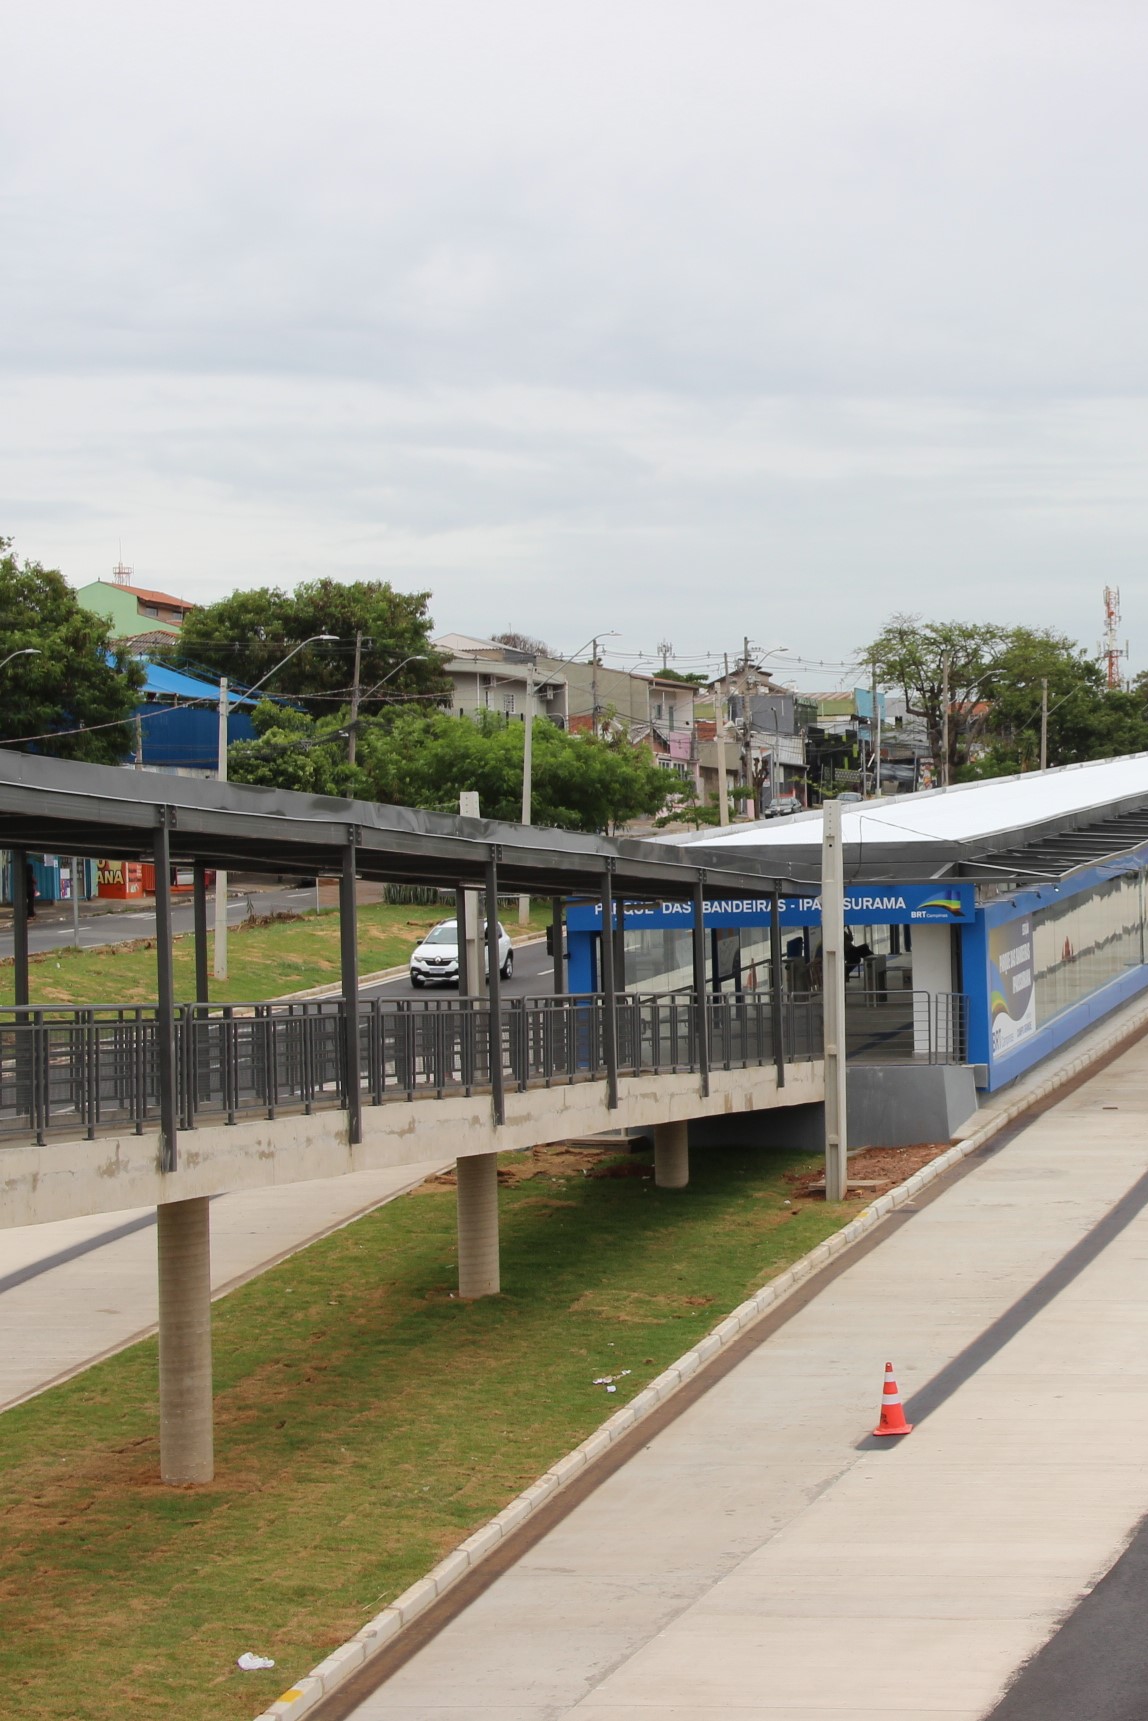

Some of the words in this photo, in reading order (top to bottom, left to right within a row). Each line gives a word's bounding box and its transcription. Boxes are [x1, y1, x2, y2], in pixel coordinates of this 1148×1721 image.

[662, 902, 692, 914] DAS
[702, 900, 786, 913] BANDEIRAS
[799, 897, 906, 912] IPASURAMA
